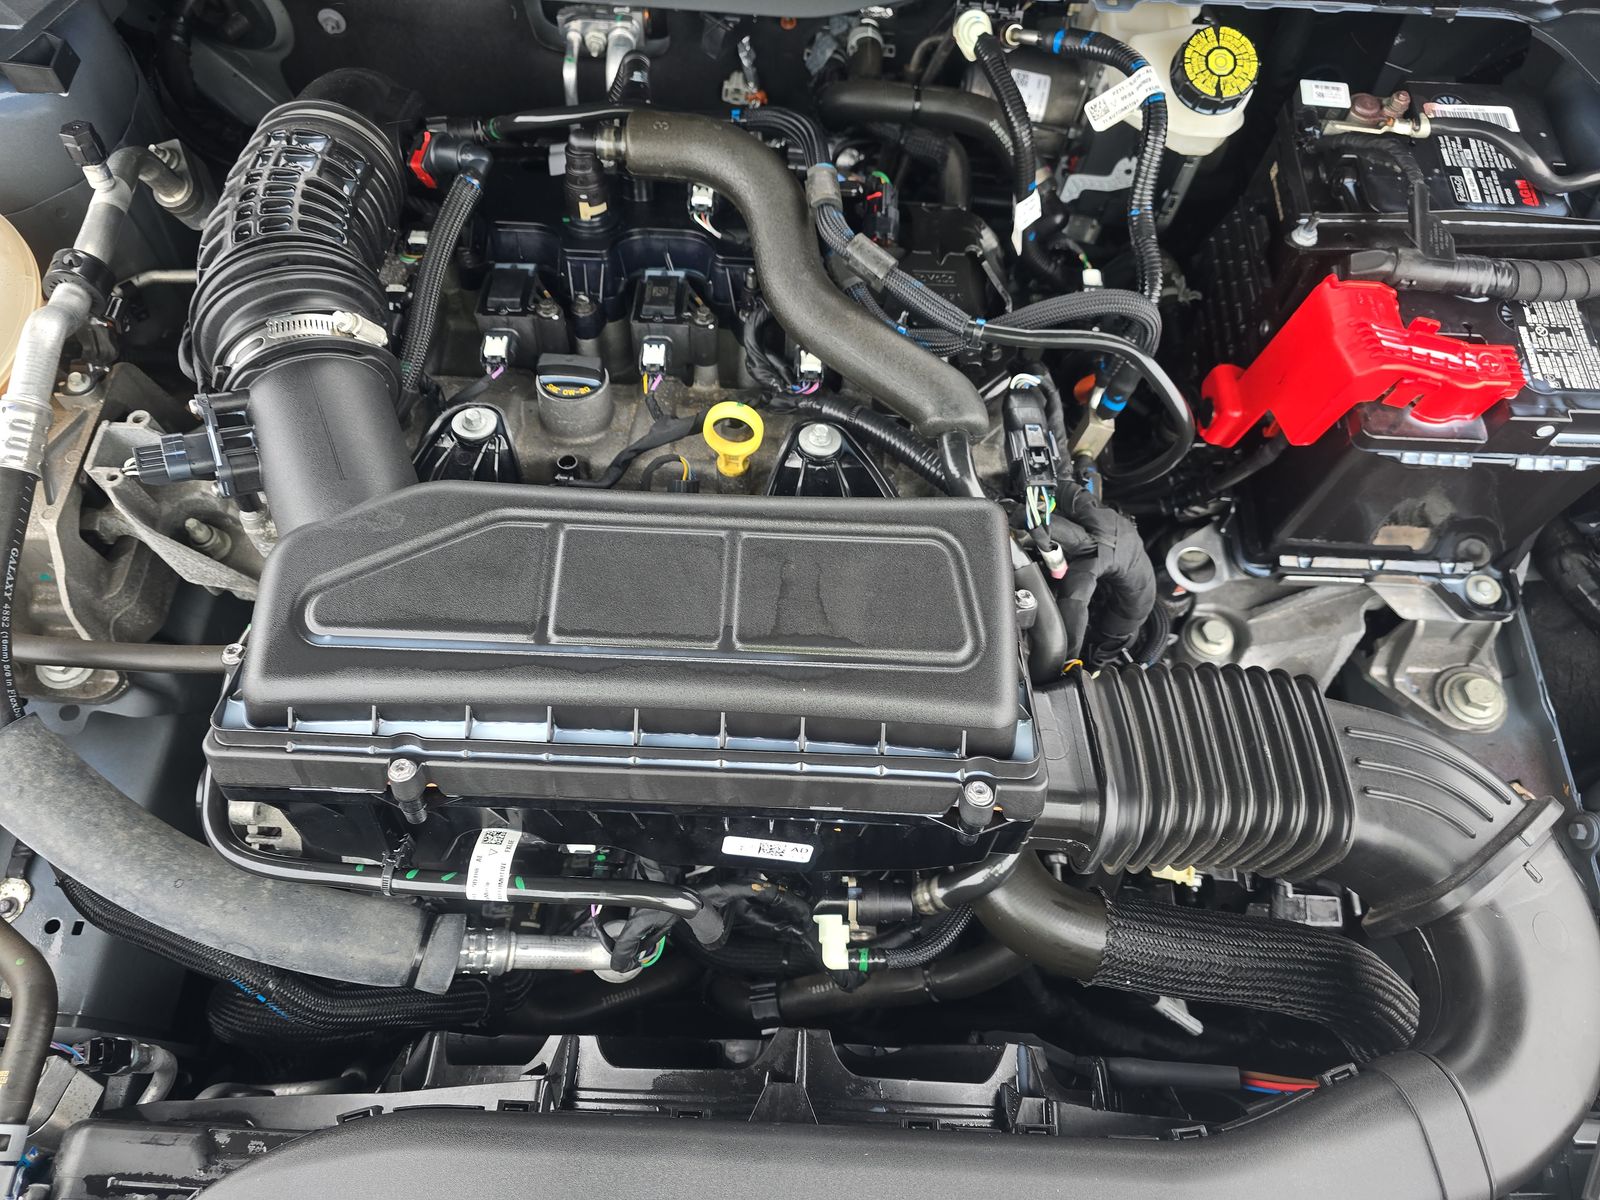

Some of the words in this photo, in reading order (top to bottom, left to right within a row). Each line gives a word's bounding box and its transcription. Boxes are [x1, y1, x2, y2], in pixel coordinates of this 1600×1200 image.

[1515, 179, 1536, 207] AGM
[4, 547, 19, 601] GALAXY
[1, 603, 11, 628] 4882
